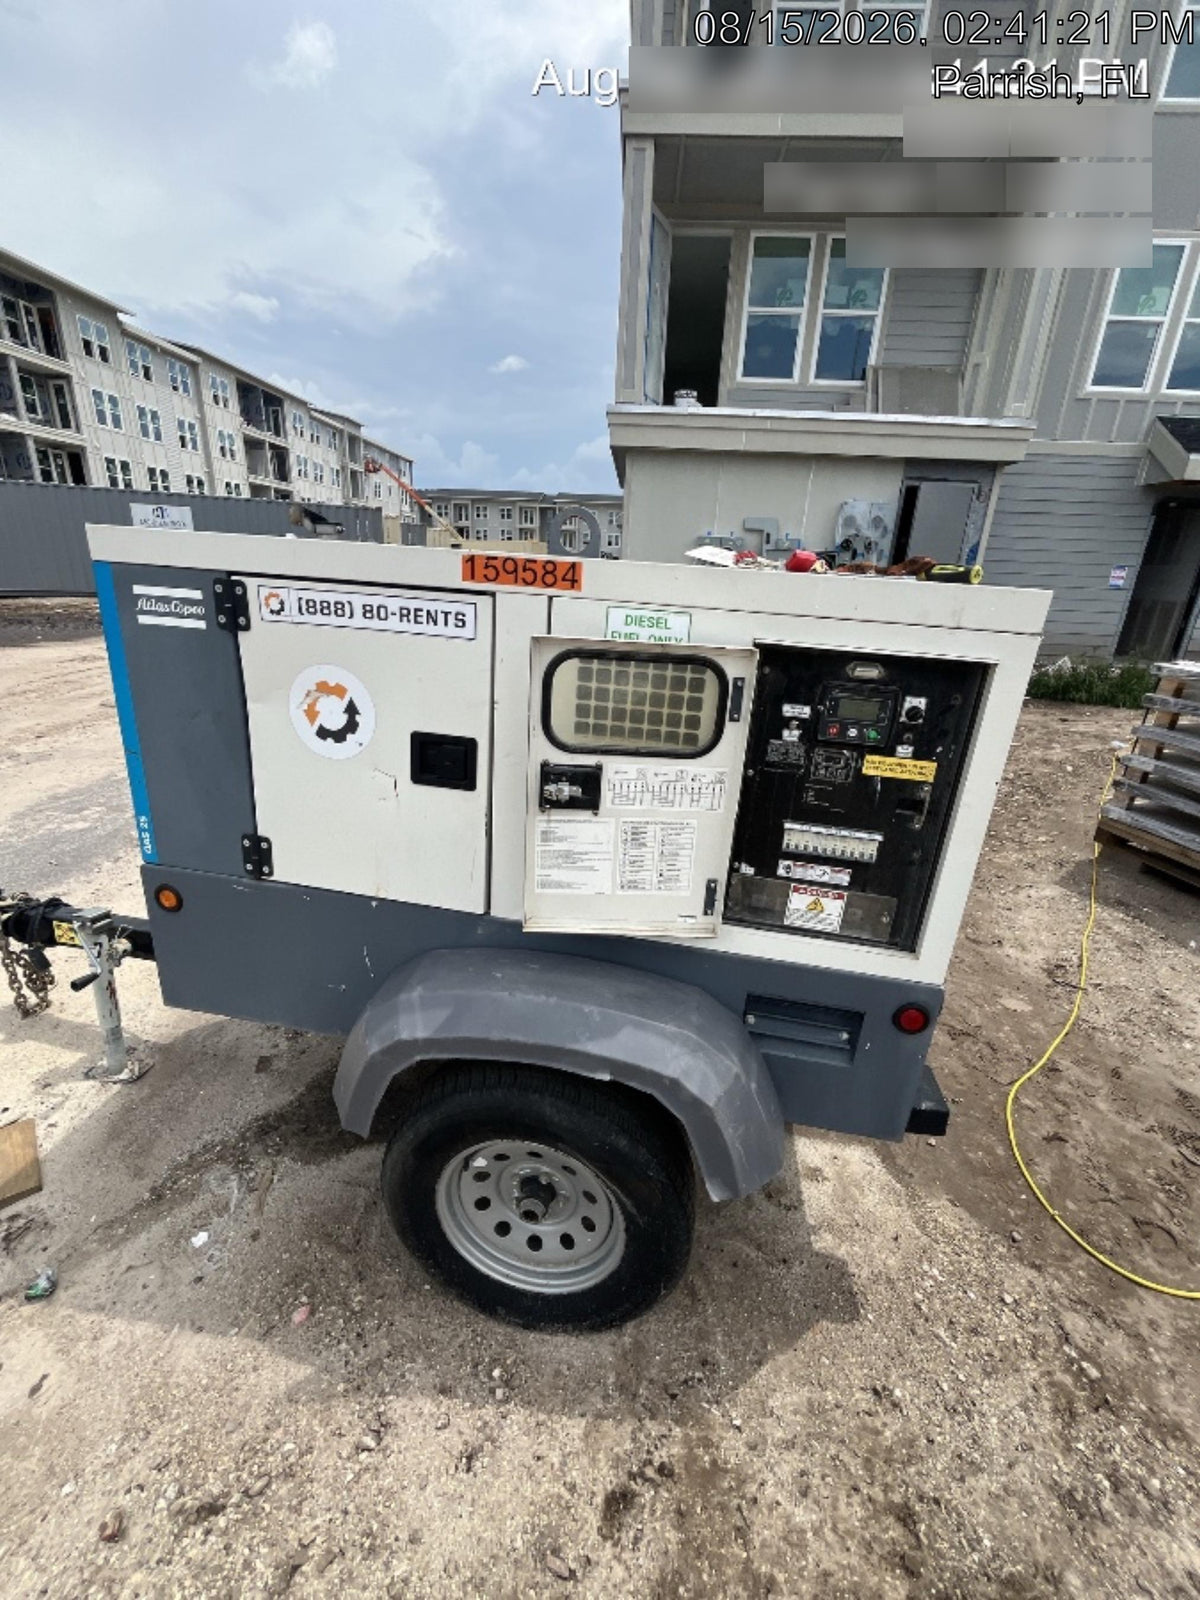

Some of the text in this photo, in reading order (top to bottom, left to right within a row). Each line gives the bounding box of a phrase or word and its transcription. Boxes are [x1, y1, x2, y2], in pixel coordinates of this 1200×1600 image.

[465, 554, 579, 589] 159584
[136, 597, 206, 616] Atlas Copco
[298, 596, 467, 628] (888) 80-RENTS
[624, 614, 672, 630] DIESEL
